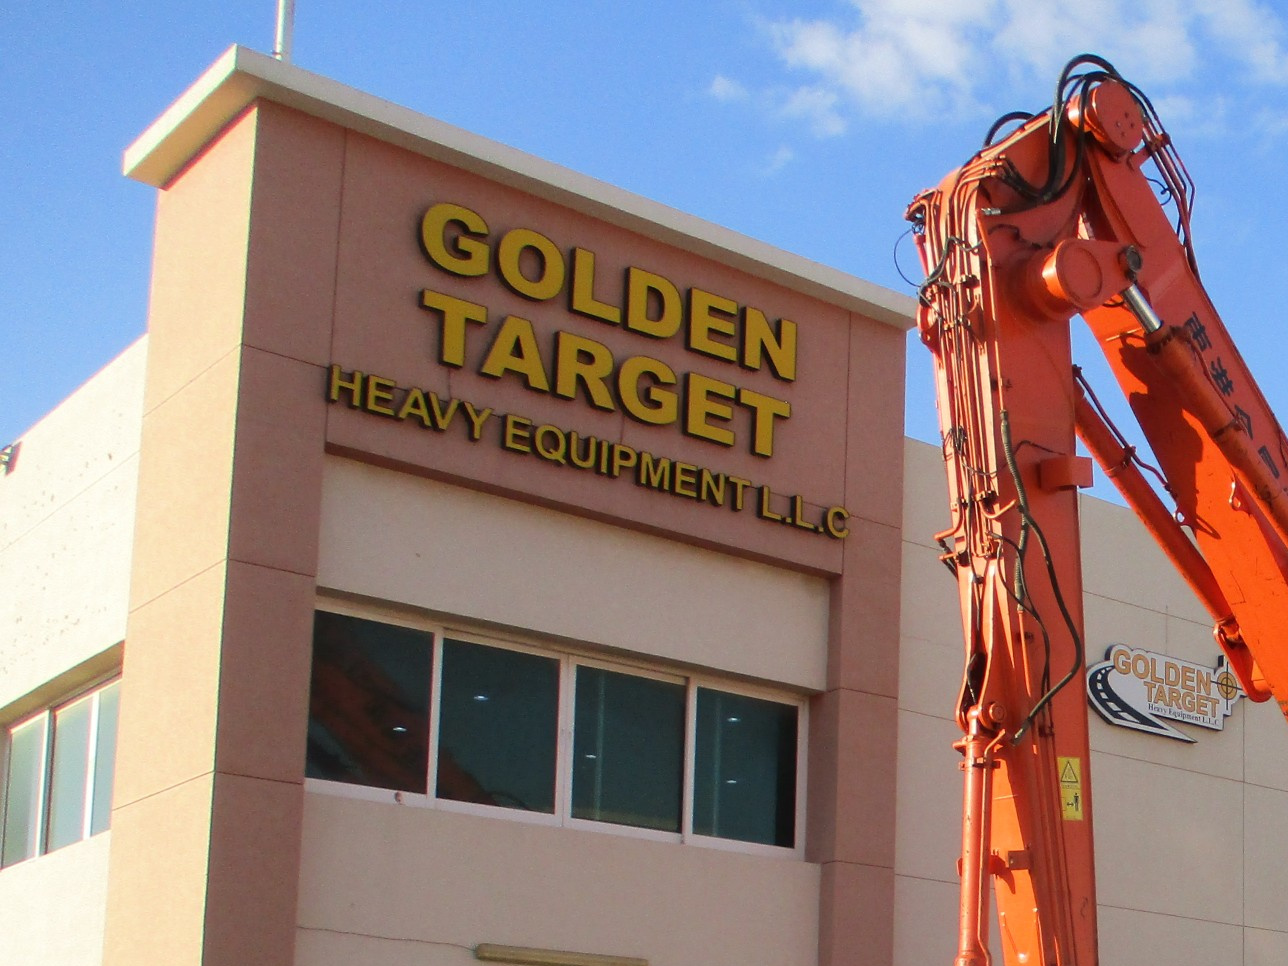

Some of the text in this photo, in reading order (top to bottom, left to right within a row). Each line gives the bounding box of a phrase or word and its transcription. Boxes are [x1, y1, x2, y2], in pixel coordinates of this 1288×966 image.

[419, 200, 798, 382] GOLDEN
[419, 287, 792, 459] TARGET
[327, 363, 851, 539] HEAVY EQUIPMENT L.L.C
[1113, 649, 1211, 695] GOLDEN
[1143, 681, 1219, 717] TARGET
[1147, 702, 1168, 714] Heavy
[1168, 707, 1201, 722] Equipment
